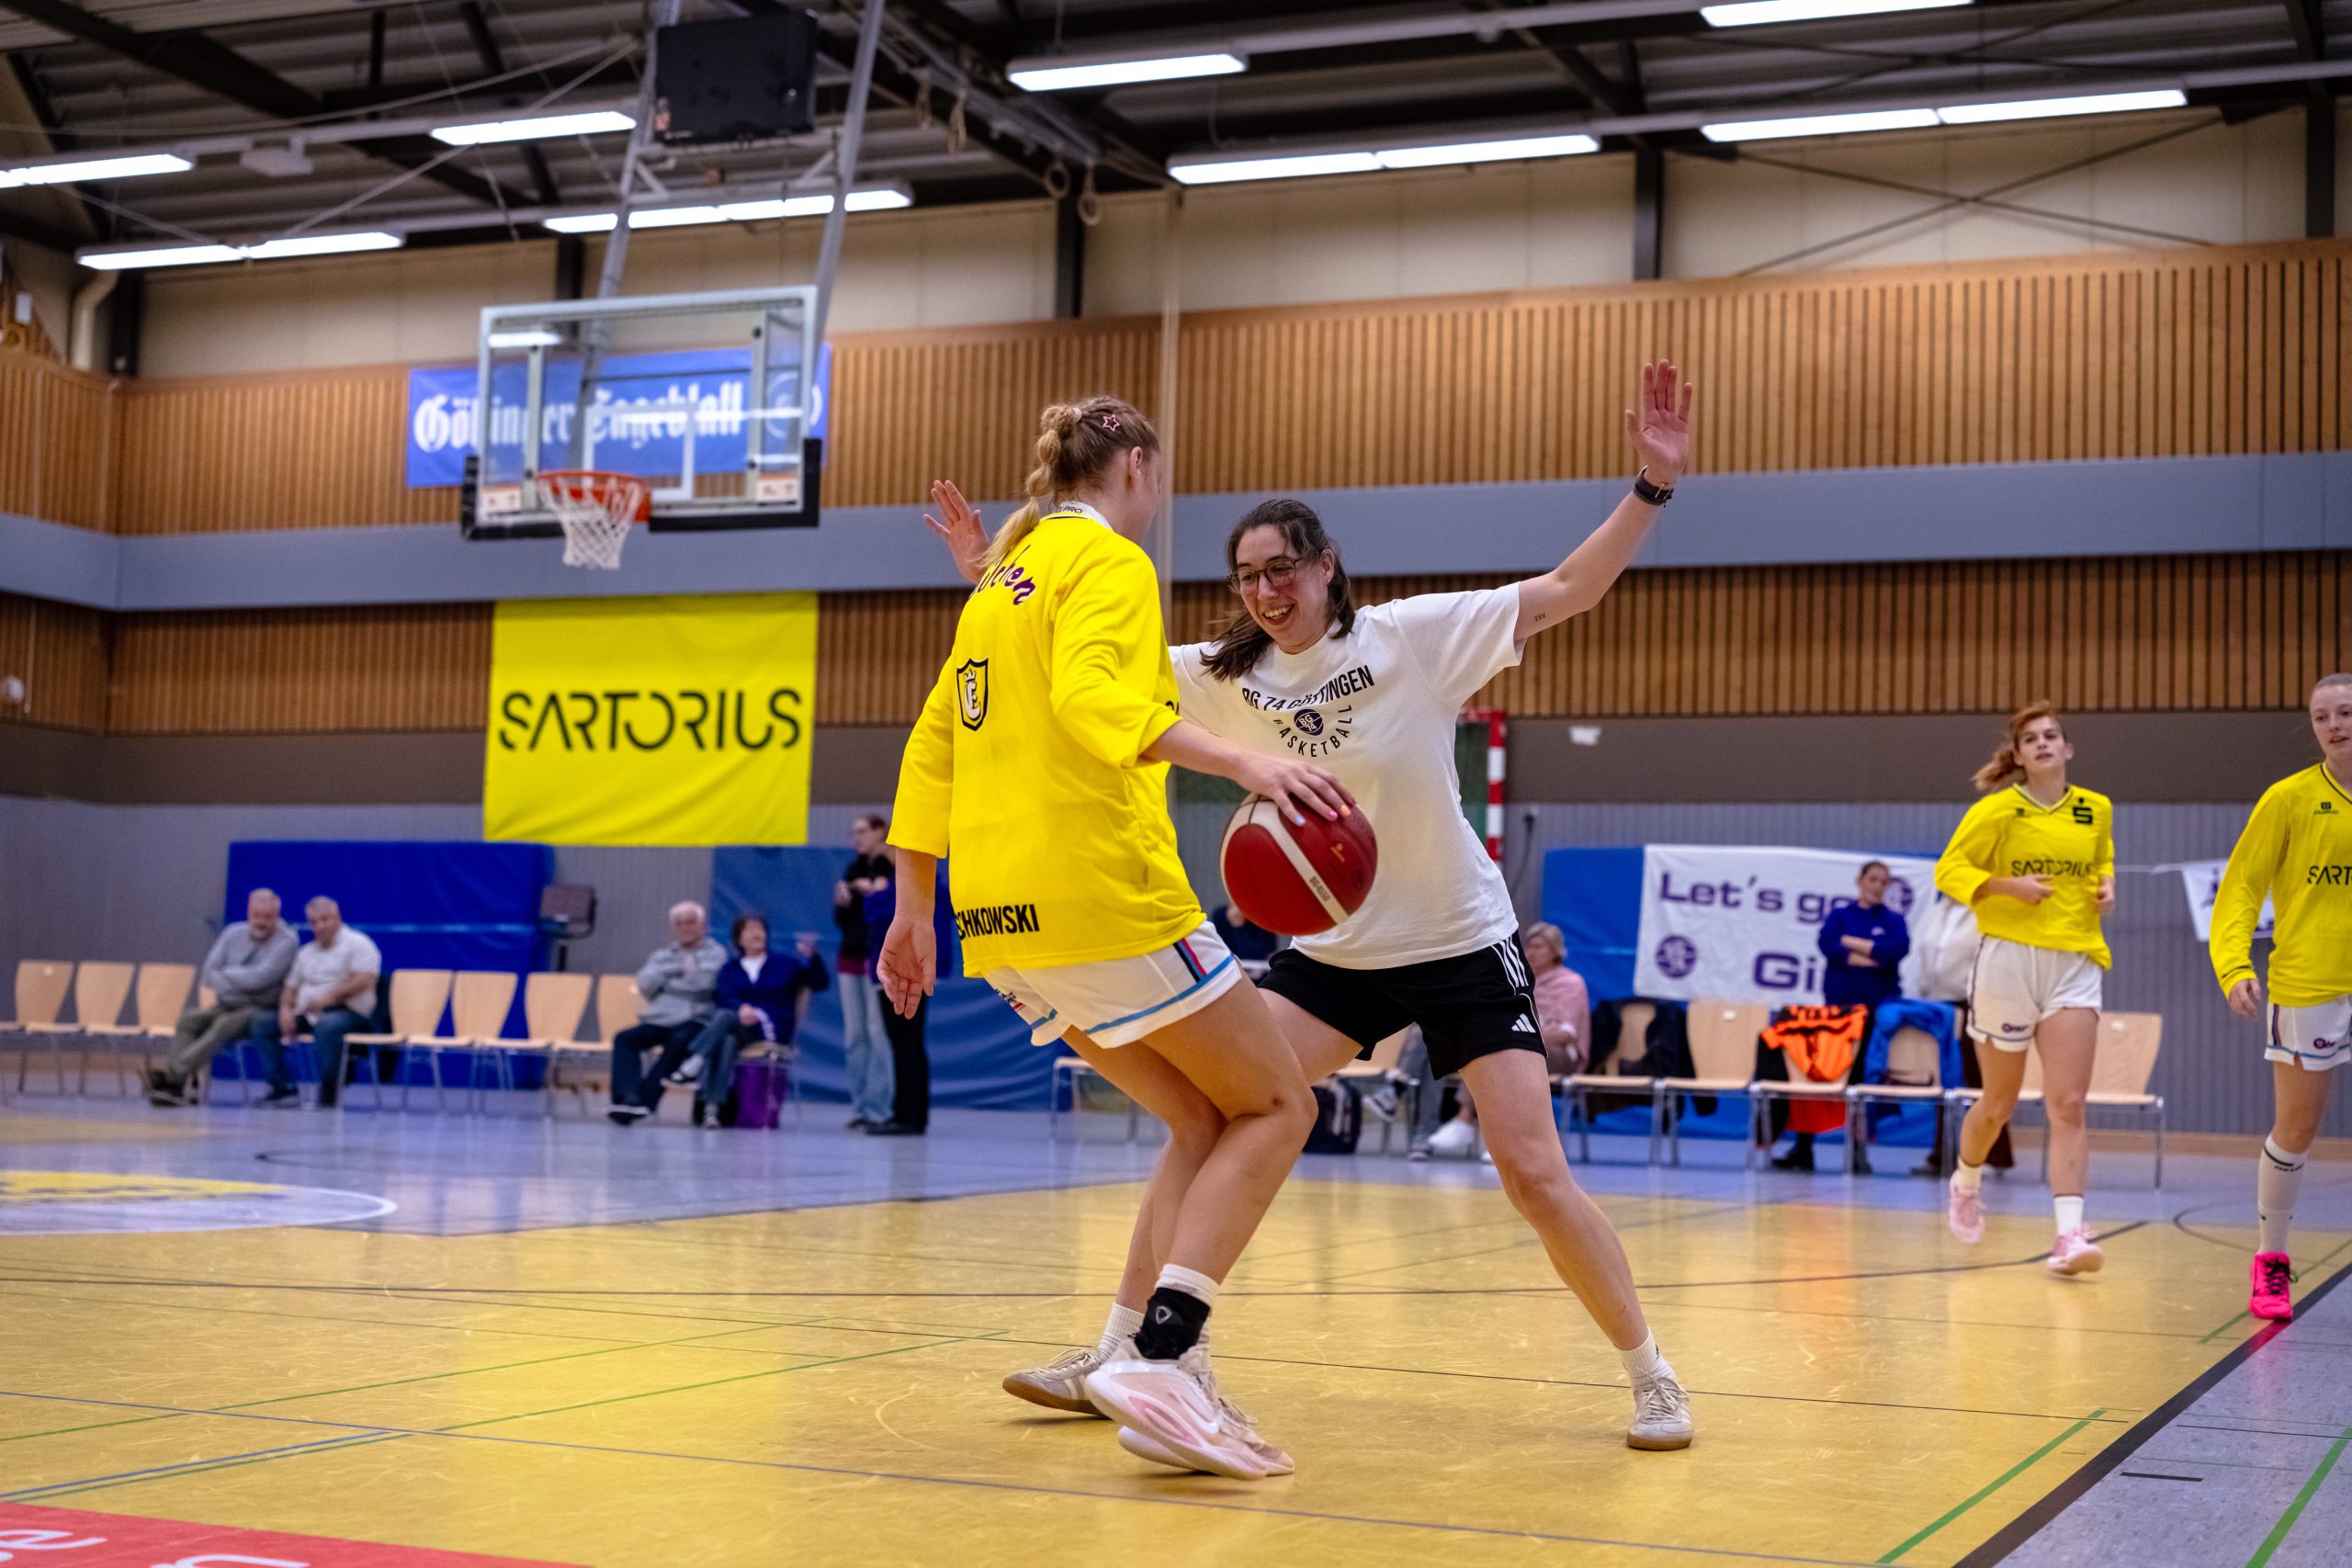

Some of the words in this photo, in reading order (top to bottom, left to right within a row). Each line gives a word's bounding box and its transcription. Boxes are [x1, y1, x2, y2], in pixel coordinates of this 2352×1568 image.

[1264, 696, 1287, 711] 74
[1287, 665, 1375, 710] GÖTTINGEN
[500, 688, 803, 751] SARTORIUS
[1660, 873, 1784, 912] Let's
[2308, 865, 2352, 886] SART
[956, 904, 1040, 941] CHKOWSKI
